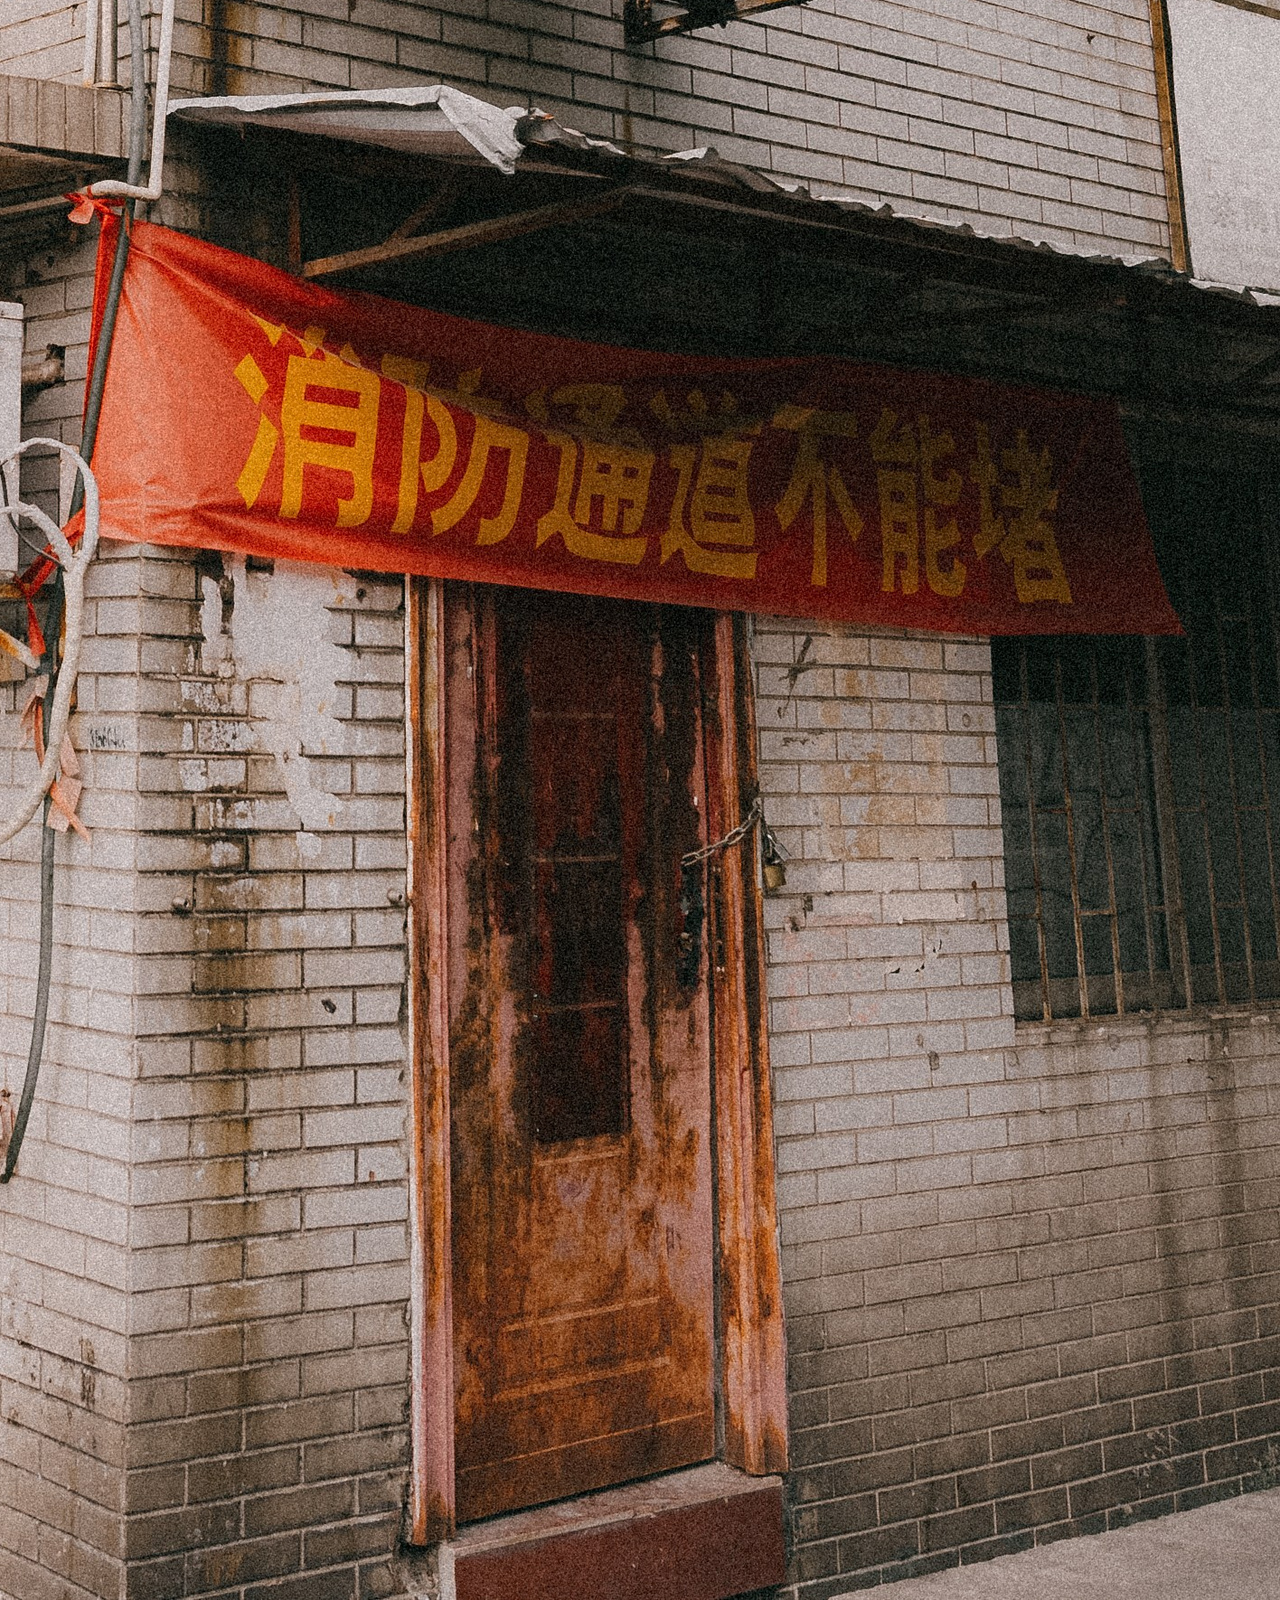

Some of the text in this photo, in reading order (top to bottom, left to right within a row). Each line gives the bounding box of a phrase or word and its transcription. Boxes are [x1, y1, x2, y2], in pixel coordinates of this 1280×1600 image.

[233, 308, 1073, 604] 消防通道不能堵
